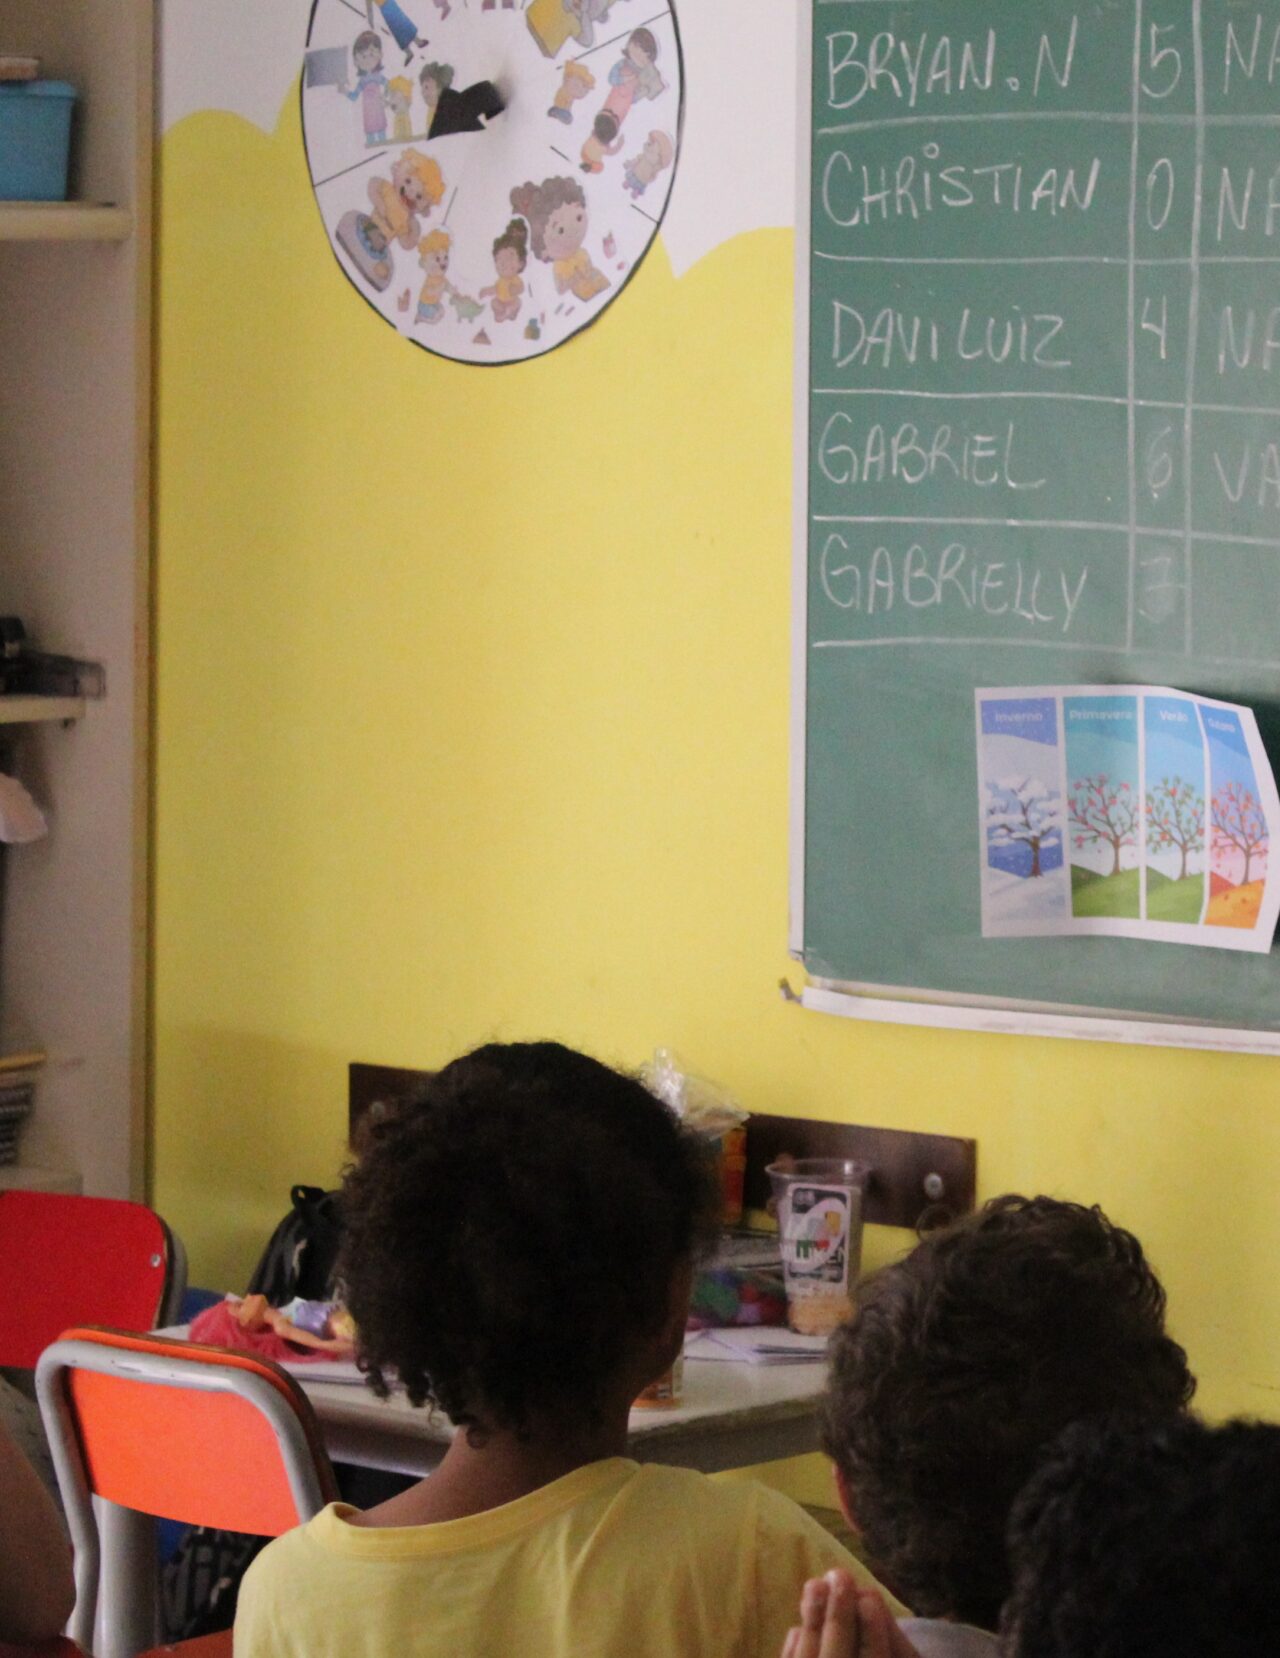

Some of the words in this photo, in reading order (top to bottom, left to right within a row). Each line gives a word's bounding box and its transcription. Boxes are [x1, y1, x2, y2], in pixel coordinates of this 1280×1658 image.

[1141, 23, 1182, 98] 5
[832, 301, 938, 368] DAVI
[1140, 296, 1168, 360] 4
[818, 411, 1046, 489] GABRIEL
[820, 533, 1088, 632] GABRIELLY
